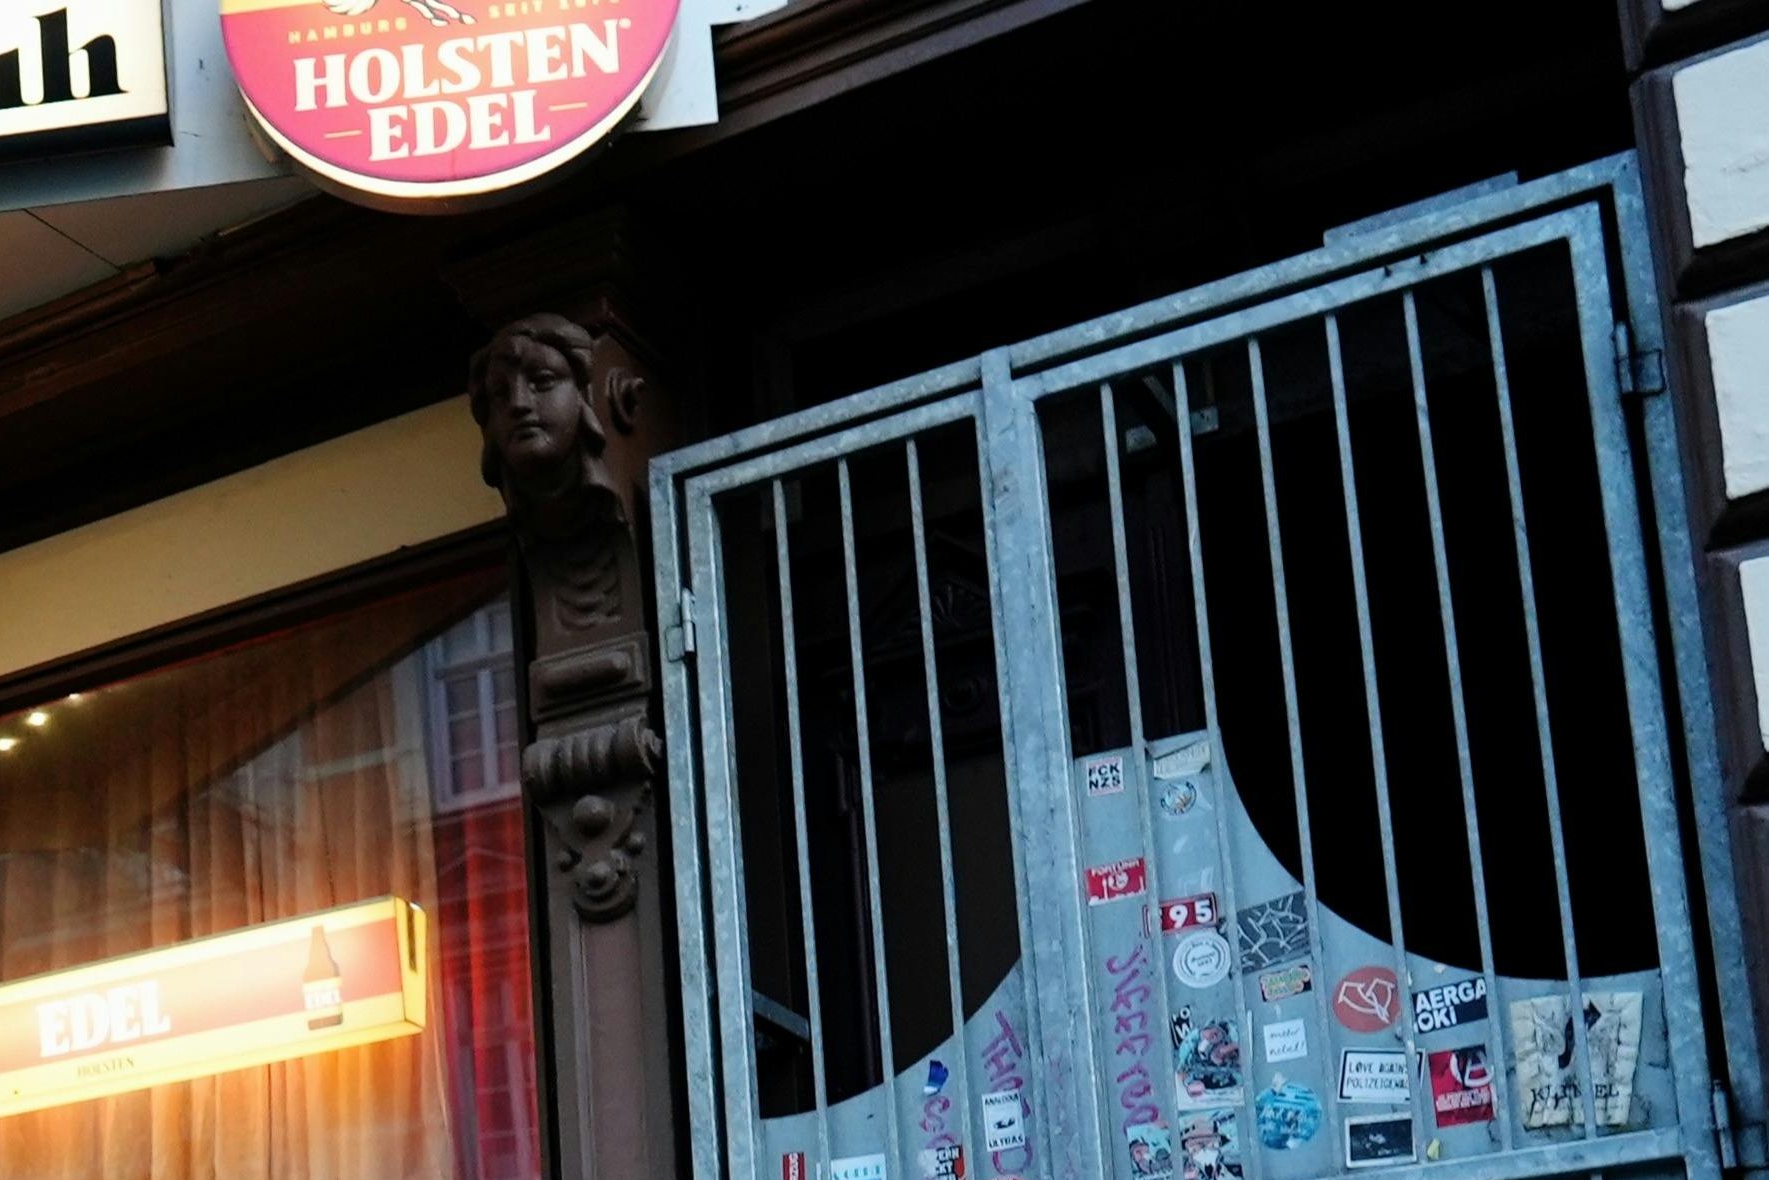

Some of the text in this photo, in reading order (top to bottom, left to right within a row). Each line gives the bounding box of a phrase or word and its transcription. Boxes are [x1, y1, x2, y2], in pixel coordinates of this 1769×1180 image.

[288, 16, 408, 45] HAMBURG
[293, 18, 621, 112] HOLSTEN
[367, 90, 551, 161] EDEL
[1088, 762, 1120, 777] FCK
[36, 979, 172, 1058] EDEL
